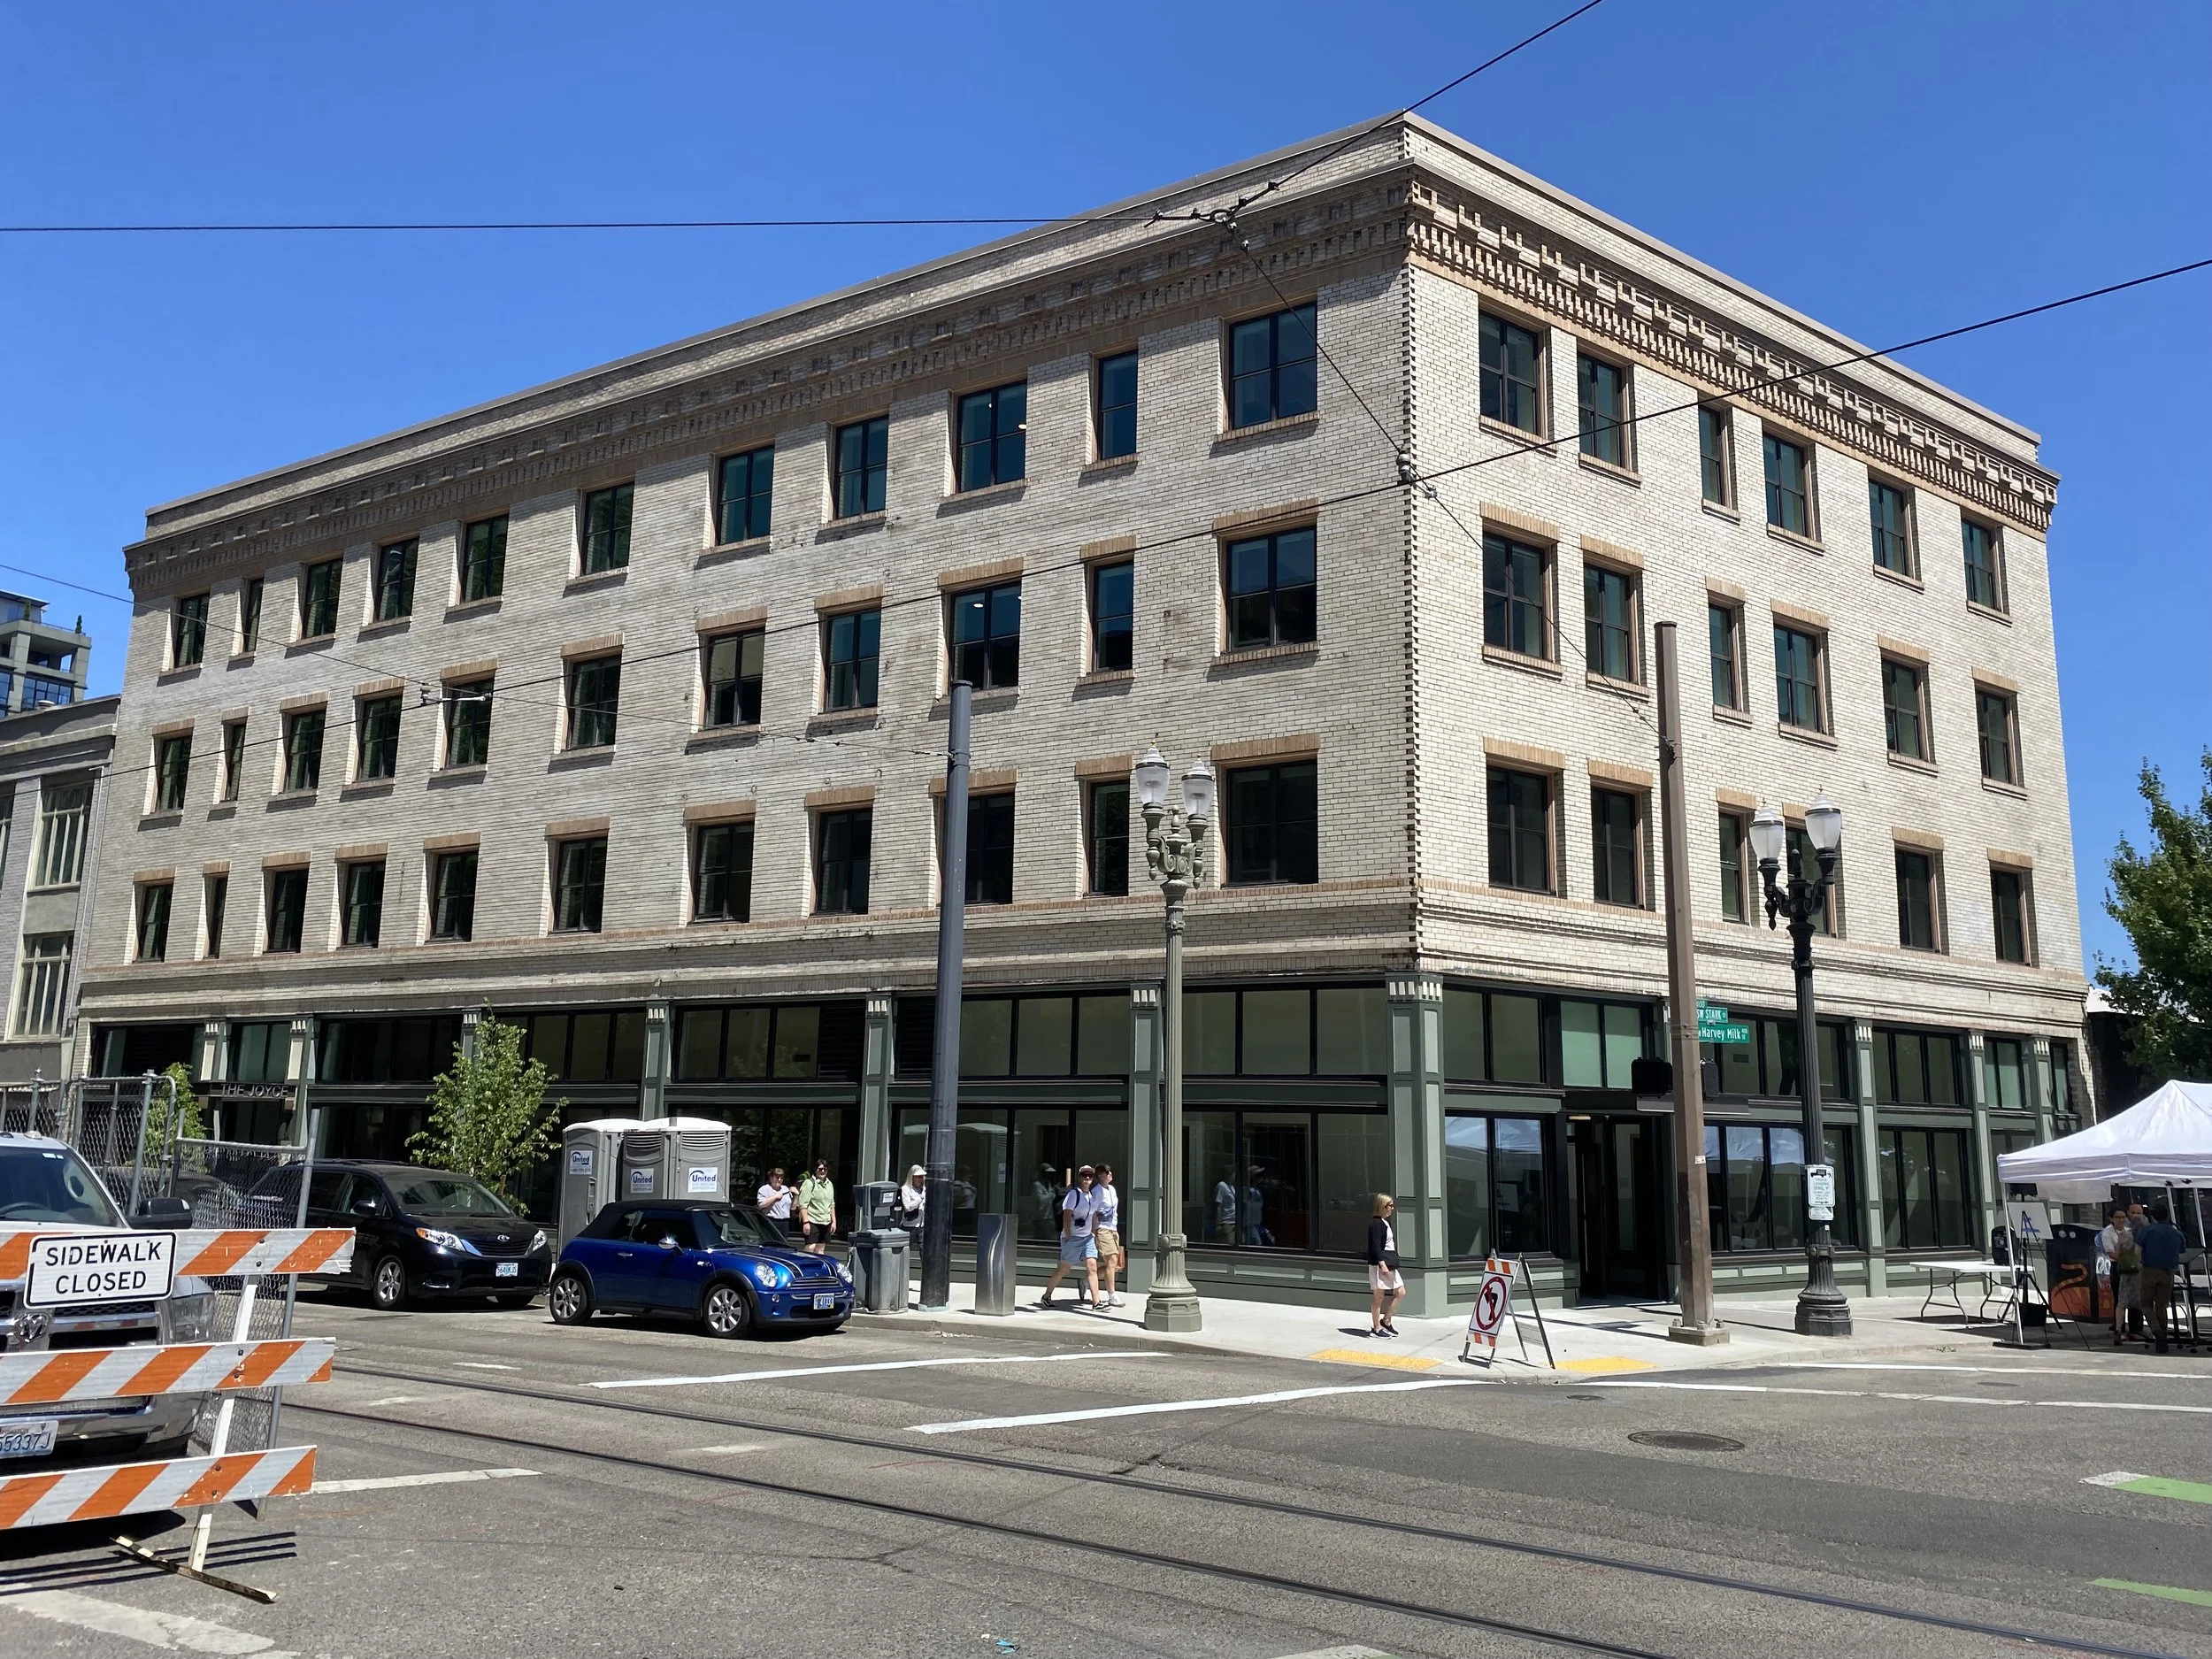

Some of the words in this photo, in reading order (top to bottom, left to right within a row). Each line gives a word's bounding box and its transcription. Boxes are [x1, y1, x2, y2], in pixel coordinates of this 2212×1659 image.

[1705, 1009, 1722, 1020] STARK
[1701, 1027, 1725, 1041] Harvey
[1727, 1028, 1740, 1040] Milk
[221, 1083, 245, 1096] THE
[249, 1084, 288, 1097] JOYCE
[633, 1175, 652, 1184] United
[45, 1241, 163, 1267] SIDEWALK
[55, 1271, 147, 1294] CLOSED
